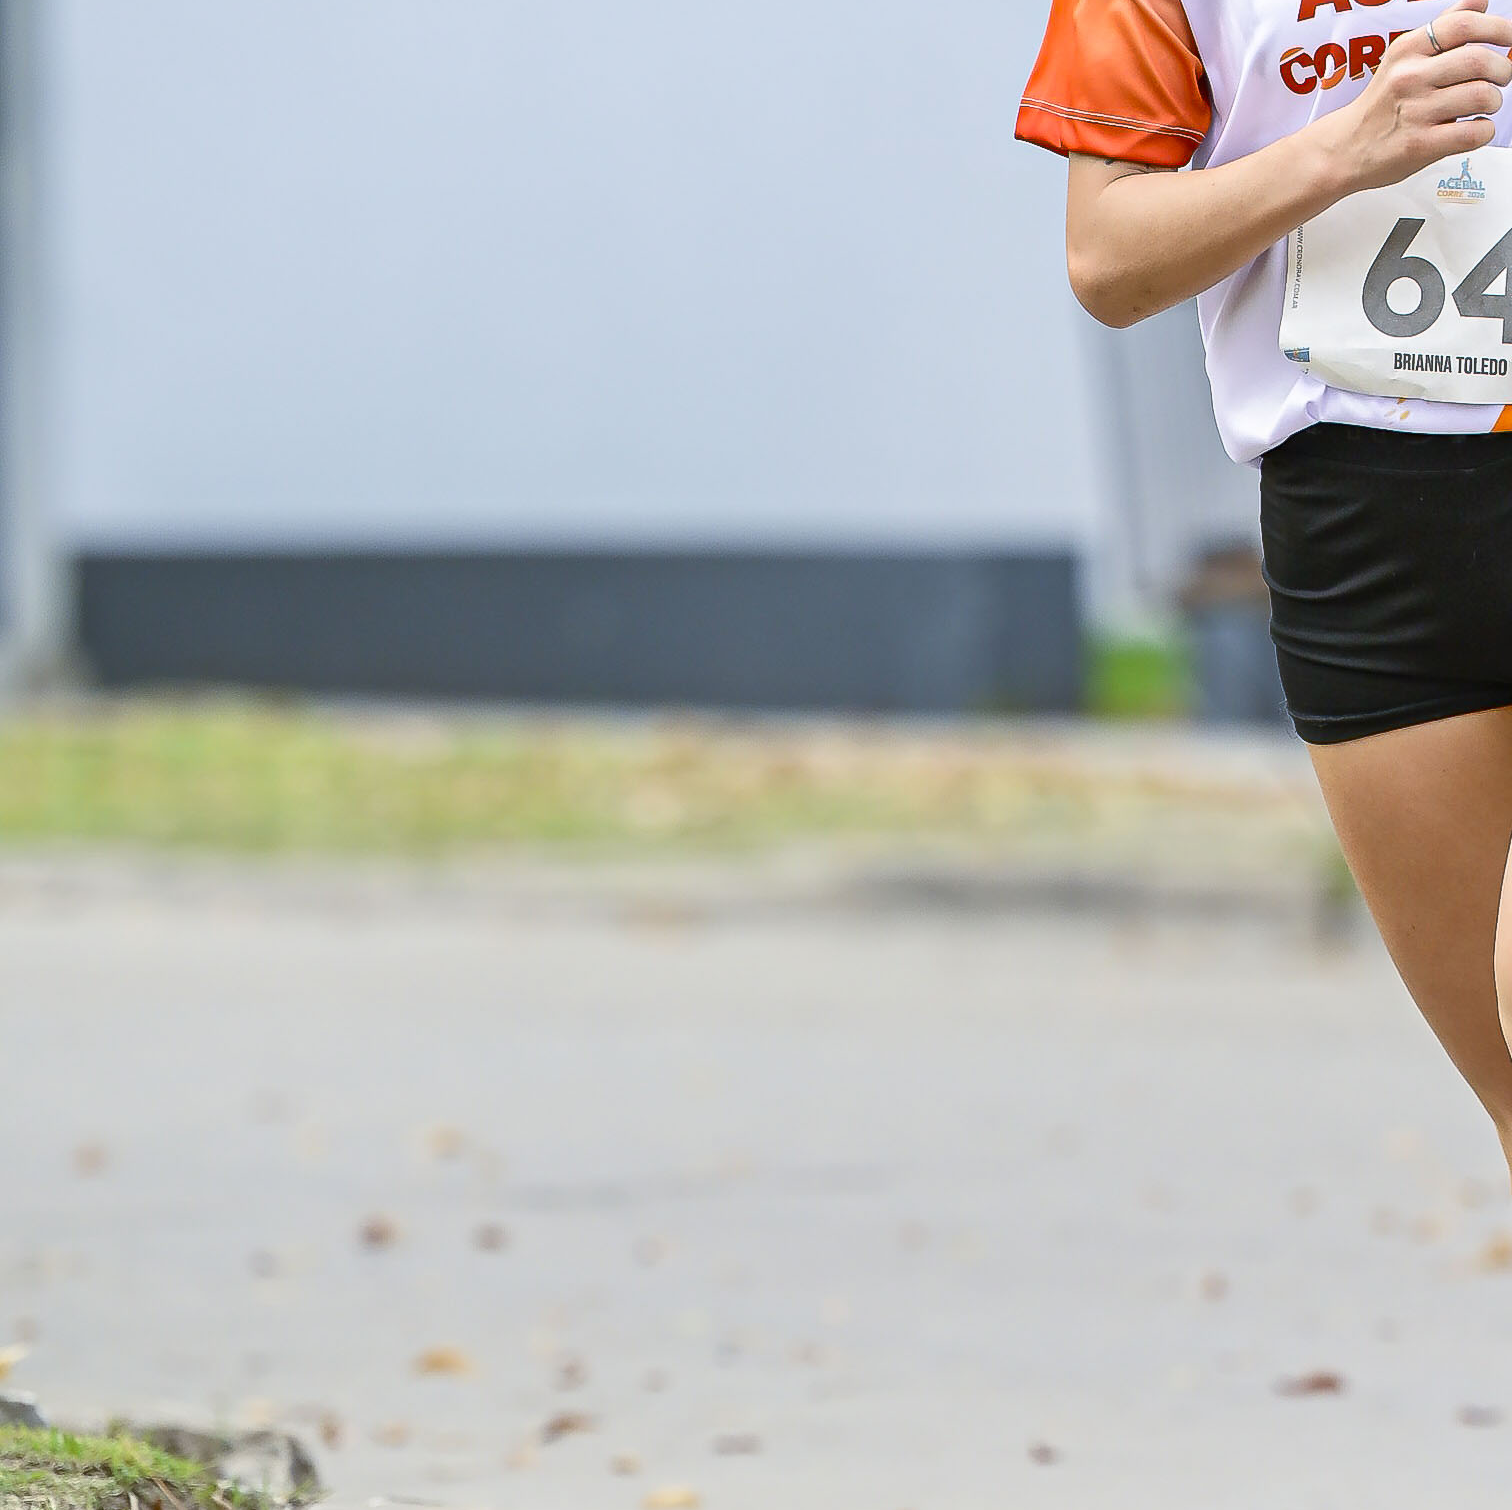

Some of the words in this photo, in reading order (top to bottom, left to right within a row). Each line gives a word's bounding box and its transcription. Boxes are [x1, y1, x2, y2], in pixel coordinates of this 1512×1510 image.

[1279, 30, 1415, 95] COR
[1437, 177, 1486, 191] ACEBAL
[1393, 352, 1453, 373] BRIANNA
[1456, 356, 1508, 376] TOLEDO
